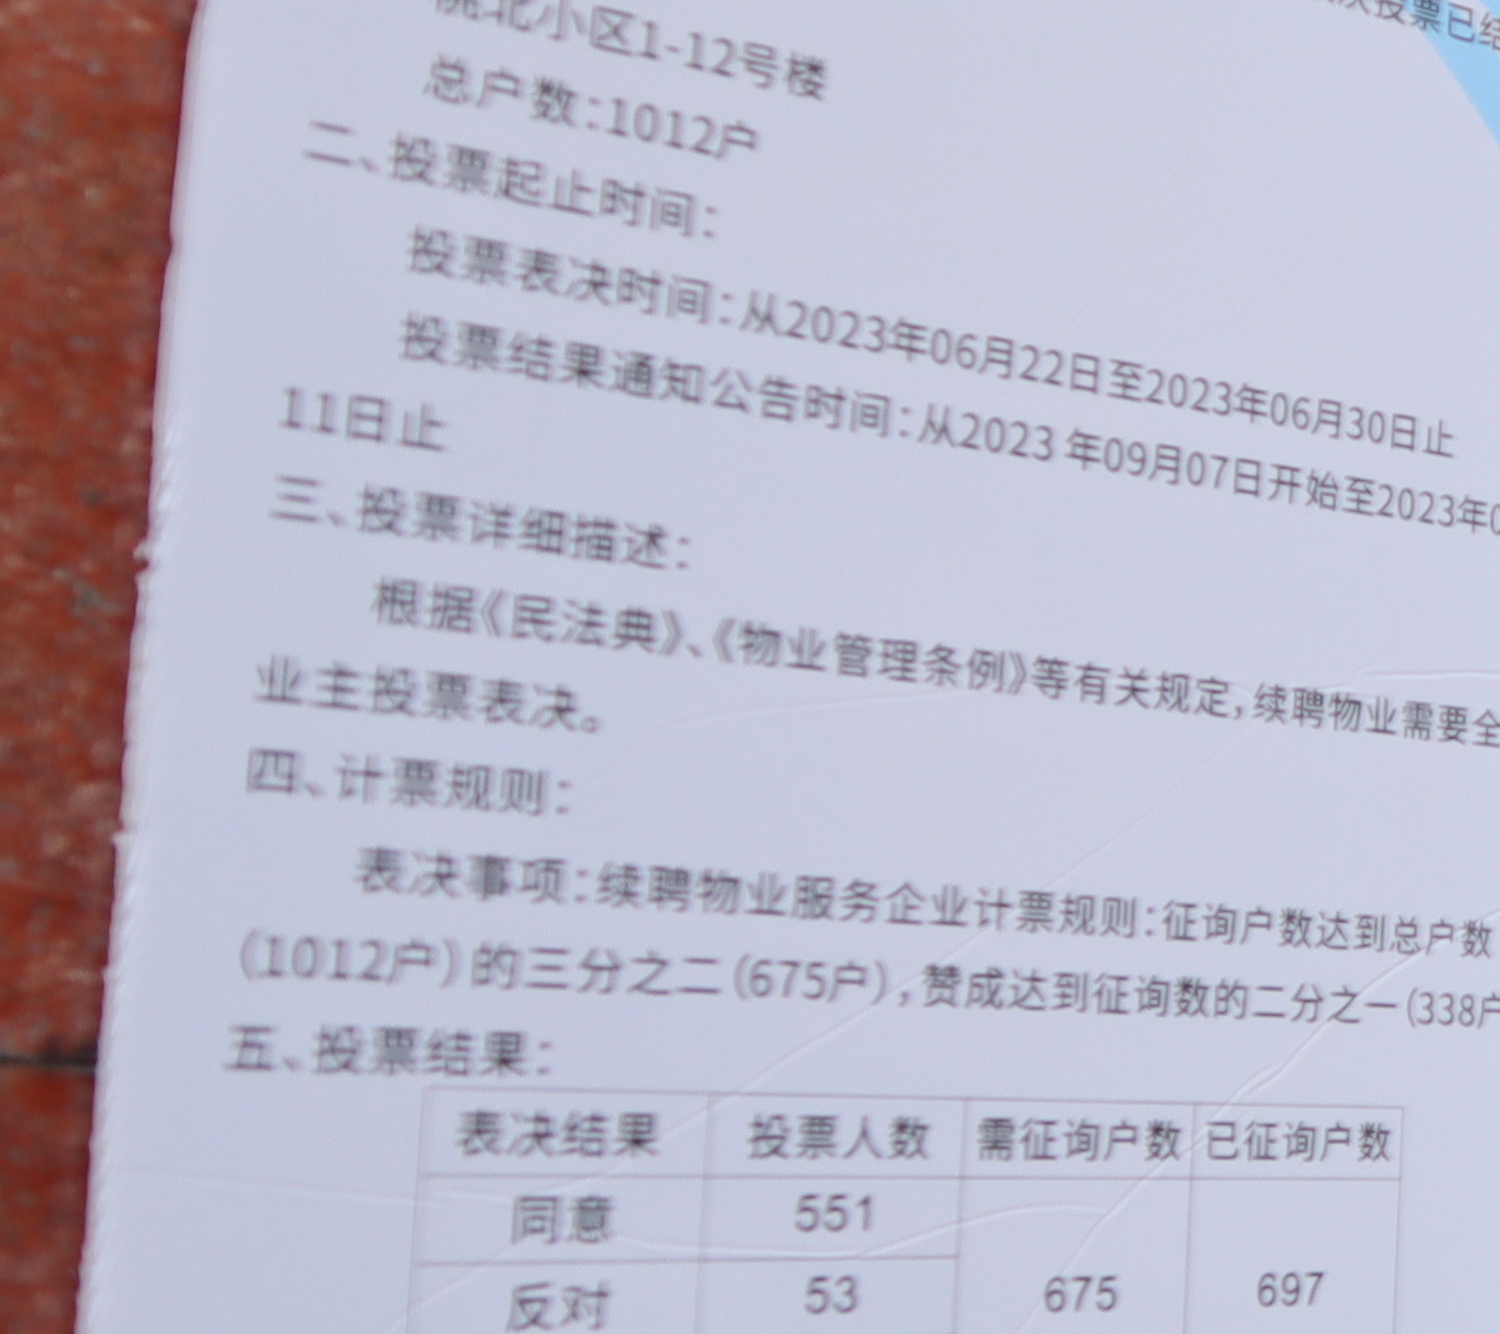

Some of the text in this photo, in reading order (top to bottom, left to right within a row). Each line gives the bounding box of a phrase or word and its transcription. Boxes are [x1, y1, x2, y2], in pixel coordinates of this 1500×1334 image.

[423, 54, 759, 160] 总户数：1012户
[301, 120, 719, 239] 二、投票起止时间：
[405, 224, 1456, 460] 投票表决时间：从2023年06月22日至2023年06月30日止
[278, 385, 448, 453] 11日止
[269, 473, 693, 570] 三、投票详细描述：
[252, 653, 602, 735] 业主投票表决。
[246, 746, 575, 818] 四、计票规则：
[353, 845, 1492, 960] 表决事项：续聘物业服务企业计票规则：征询户数达到总户数
[223, 1023, 554, 1078] 五、投票结果：
[454, 1111, 661, 1158] 表决结果
[747, 1114, 931, 1162] 投票人数
[976, 1118, 1182, 1163] 需征询户数
[1205, 1120, 1391, 1164] 已征询户数
[510, 1195, 615, 1246] 同意
[795, 1193, 876, 1232] 551
[505, 1280, 612, 1332] 反对
[803, 1275, 859, 1315] 53
[1044, 1275, 1119, 1313] 675
[1256, 1271, 1326, 1307] 697
